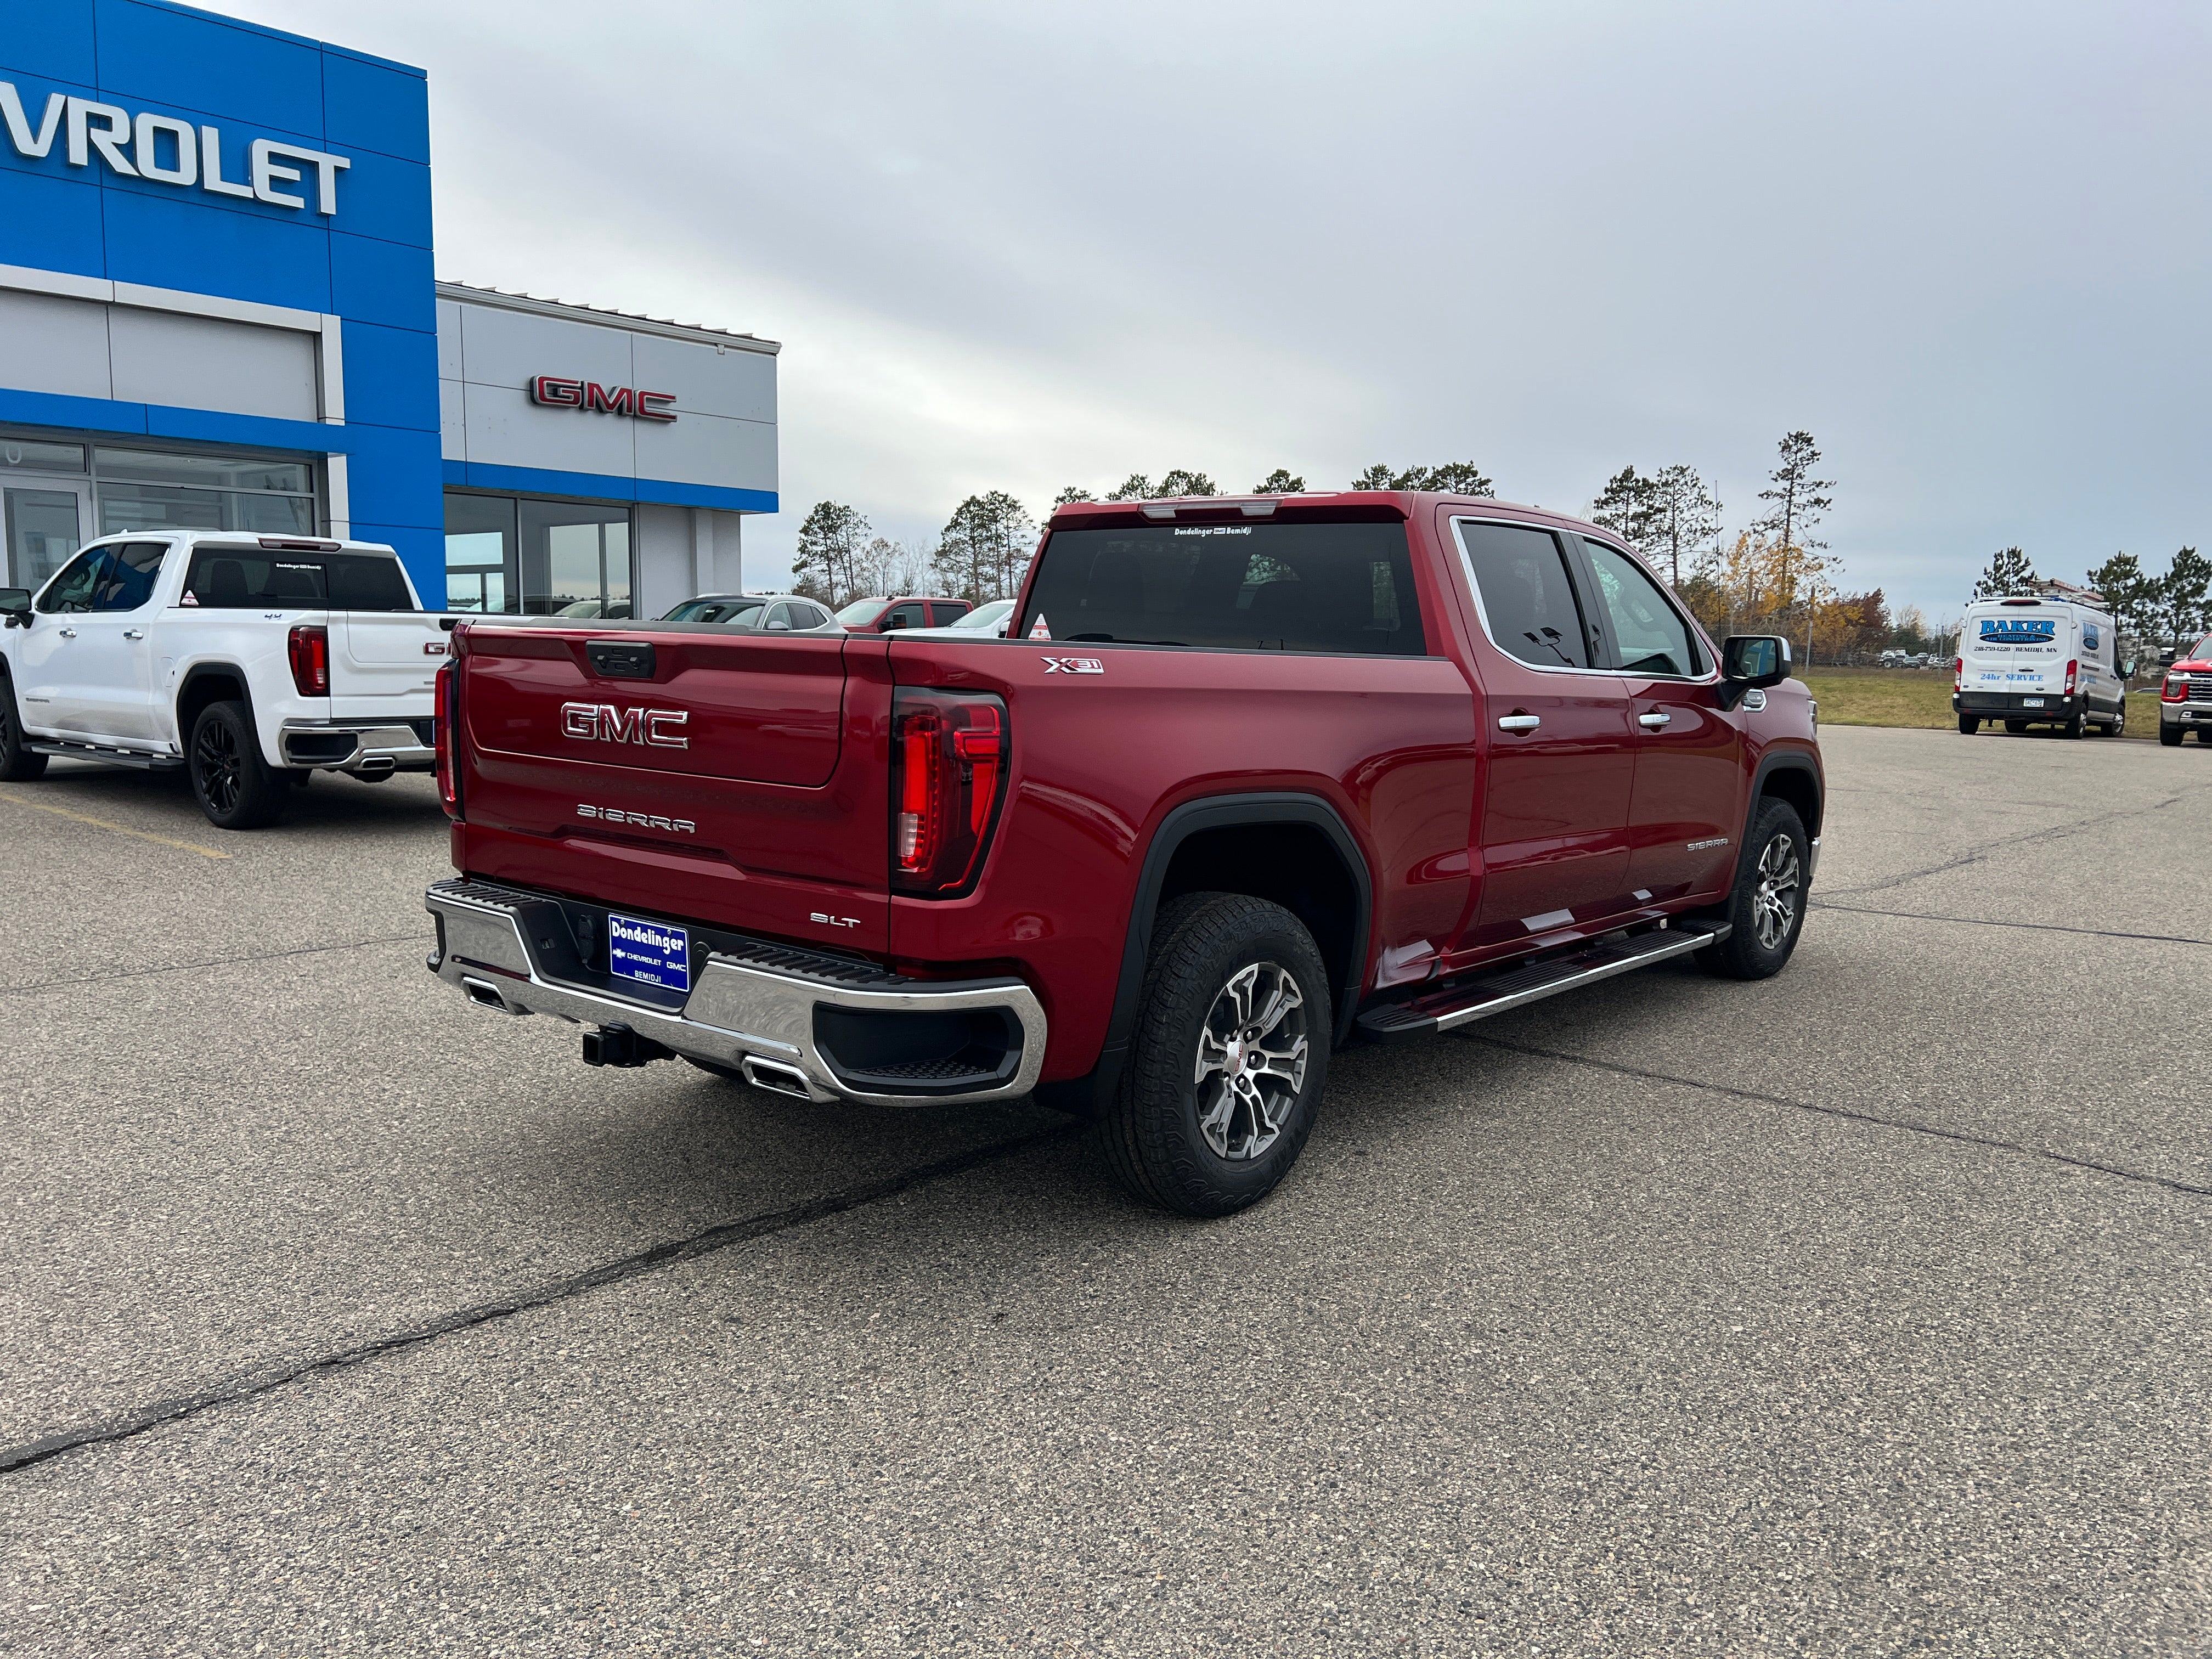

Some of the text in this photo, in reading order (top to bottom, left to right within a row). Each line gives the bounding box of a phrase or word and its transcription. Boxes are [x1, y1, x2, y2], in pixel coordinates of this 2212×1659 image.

[530, 375, 677, 422] GMC
[1174, 527, 1213, 537] Dondelinger
[1226, 527, 1252, 535] Bemidji
[1979, 620, 2056, 636] BAKER
[561, 702, 689, 750] GMC
[577, 804, 695, 833] SIERRA
[1686, 838, 1729, 851] SIERRA
[810, 912, 861, 928] SLT
[611, 921, 684, 955] Dondelinger
[627, 952, 686, 972] CHEVROLET GMC
[634, 970, 662, 983] BEMIDJI
[1234, 1044, 1243, 1071] GMC
